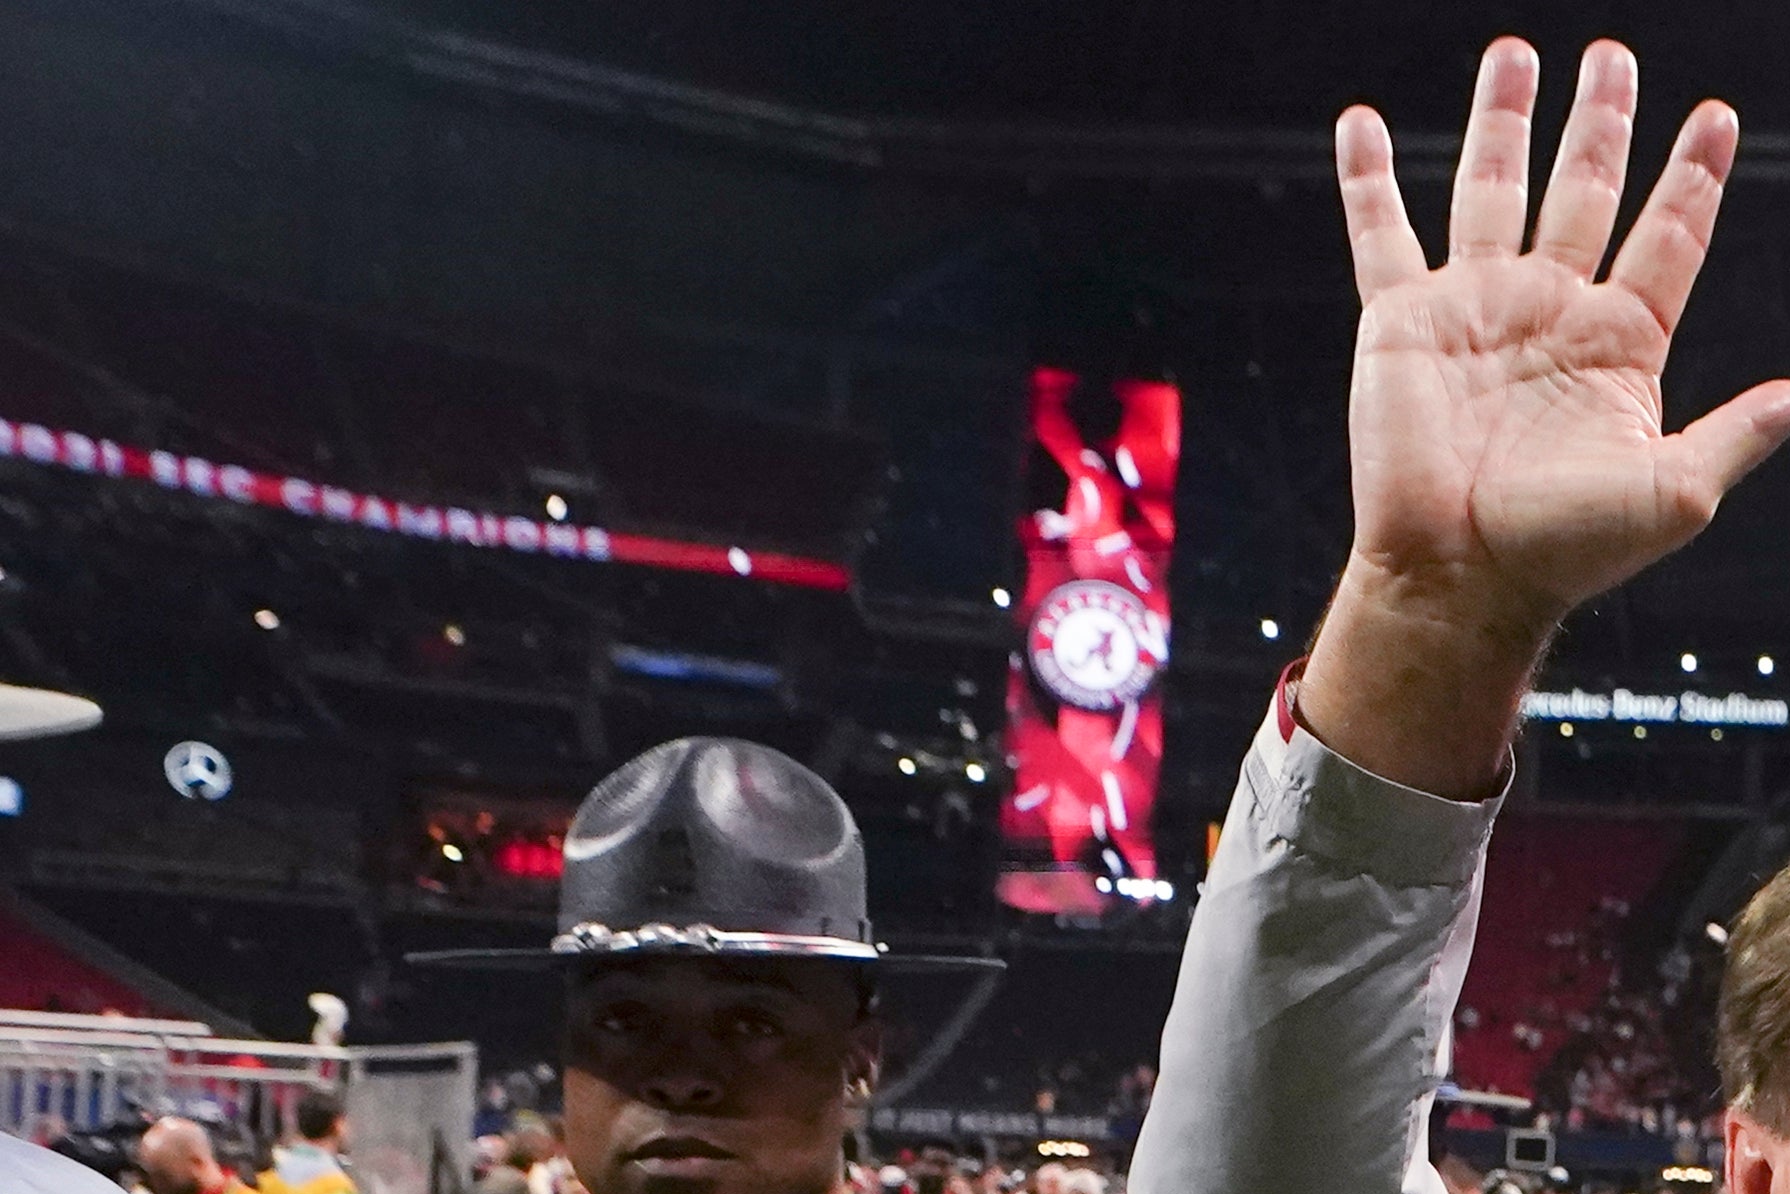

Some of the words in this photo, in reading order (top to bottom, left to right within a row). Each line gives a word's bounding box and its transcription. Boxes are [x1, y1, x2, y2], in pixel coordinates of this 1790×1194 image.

[150, 448, 256, 504] SEC
[281, 476, 612, 562] CHAMPIONS
[1680, 690, 1788, 724] Stadium
